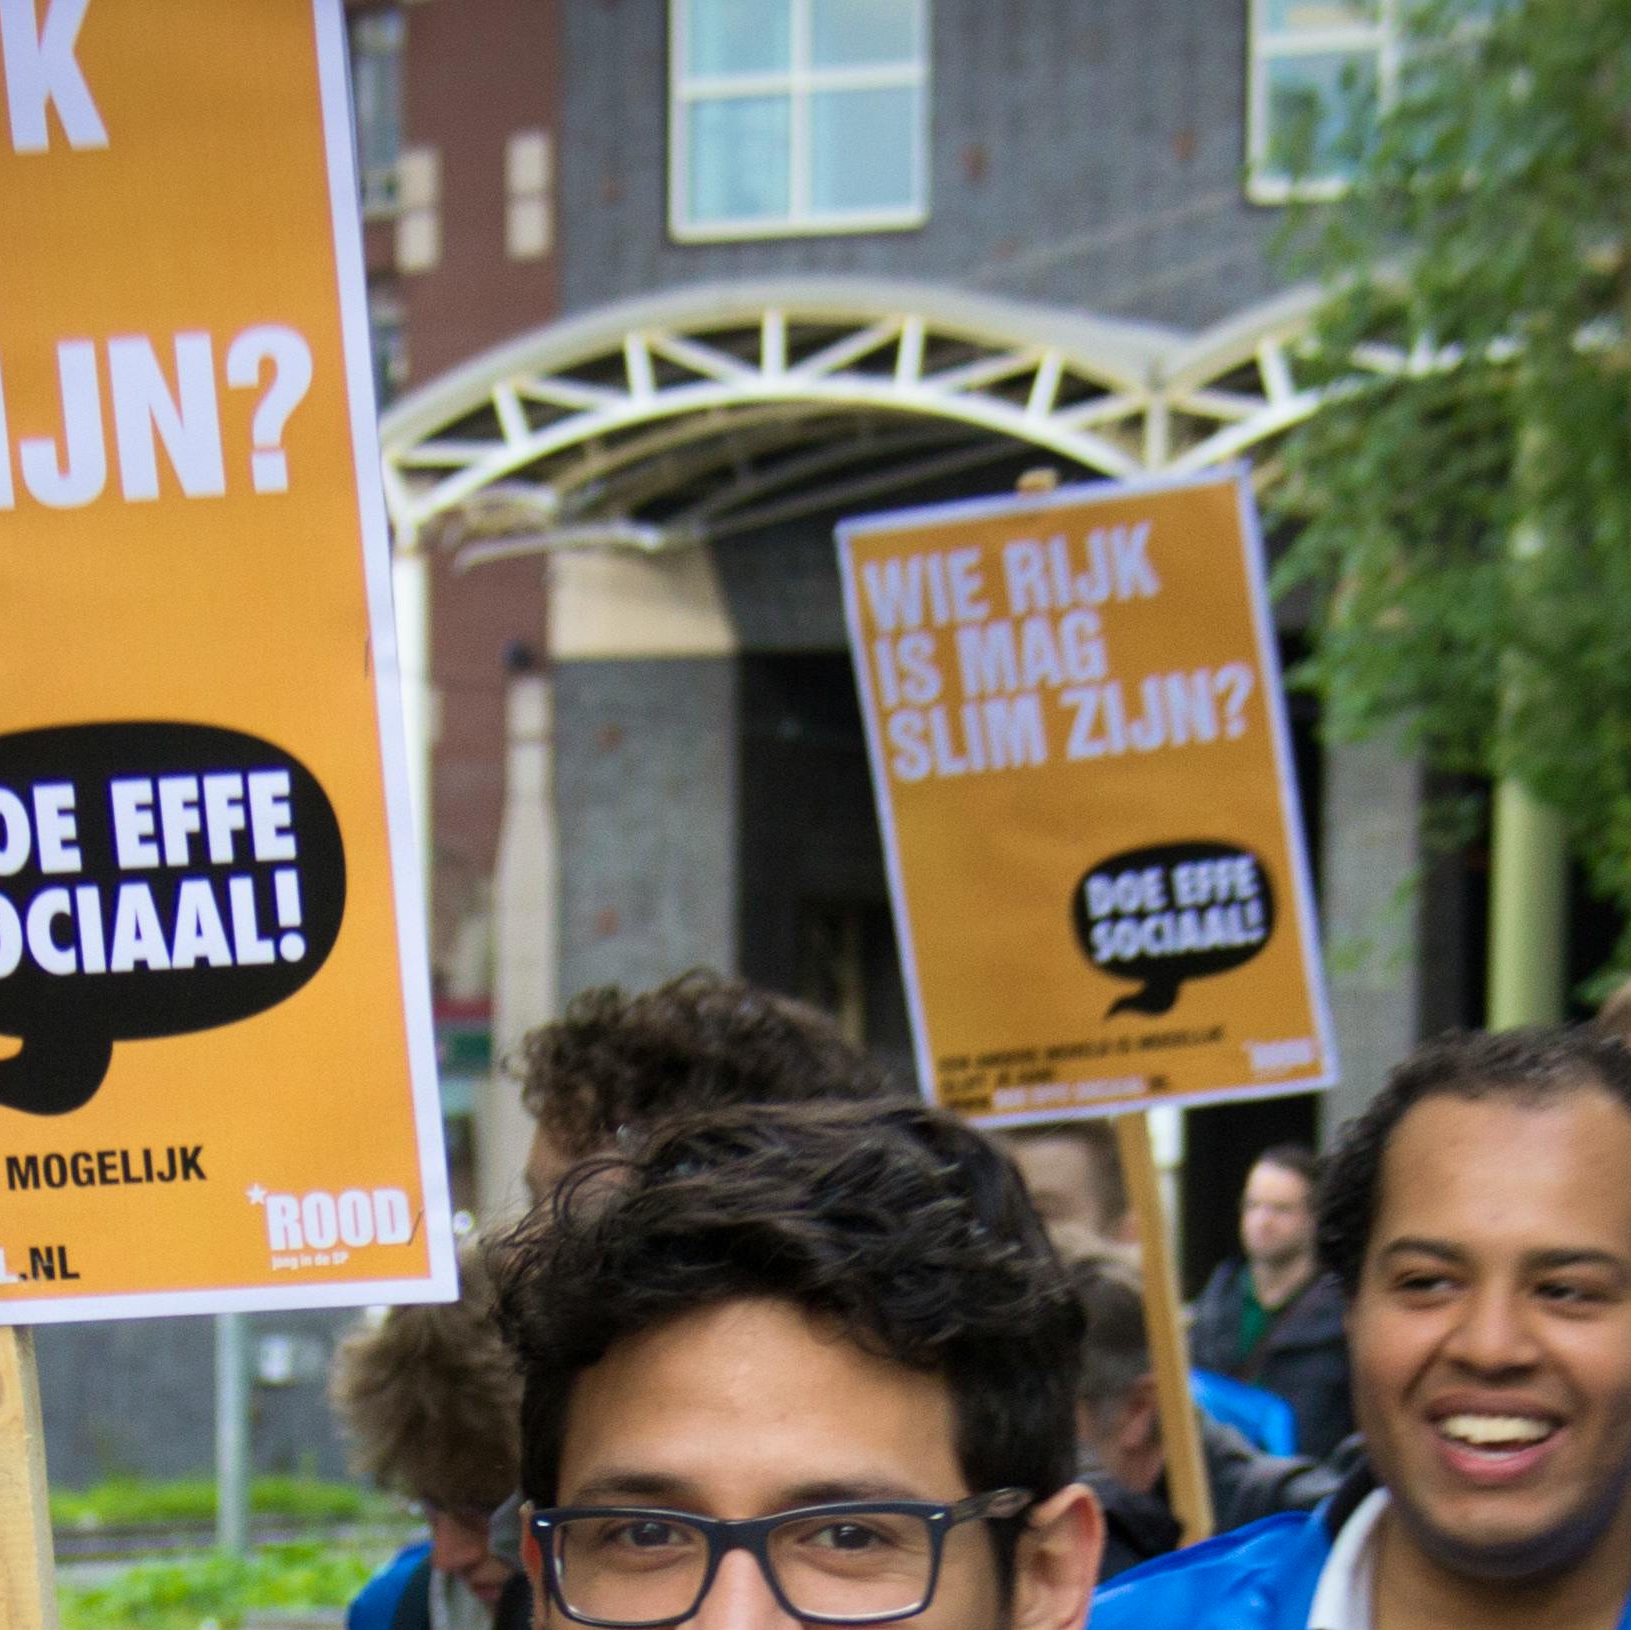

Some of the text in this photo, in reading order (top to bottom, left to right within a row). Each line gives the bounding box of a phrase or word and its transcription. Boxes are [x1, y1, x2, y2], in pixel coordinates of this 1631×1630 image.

[861, 519, 1162, 634] WIE RIJK
[874, 608, 1108, 709] IS MAG
[887, 660, 1256, 783] SLIM ZIJN?
[109, 768, 297, 870] EFFE
[1083, 852, 1260, 921] DOE EFFE
[1088, 900, 1268, 964] SOCIAAL!
[5, 1145, 208, 1191] MOGELIJK
[265, 1187, 412, 1251] ROOD
